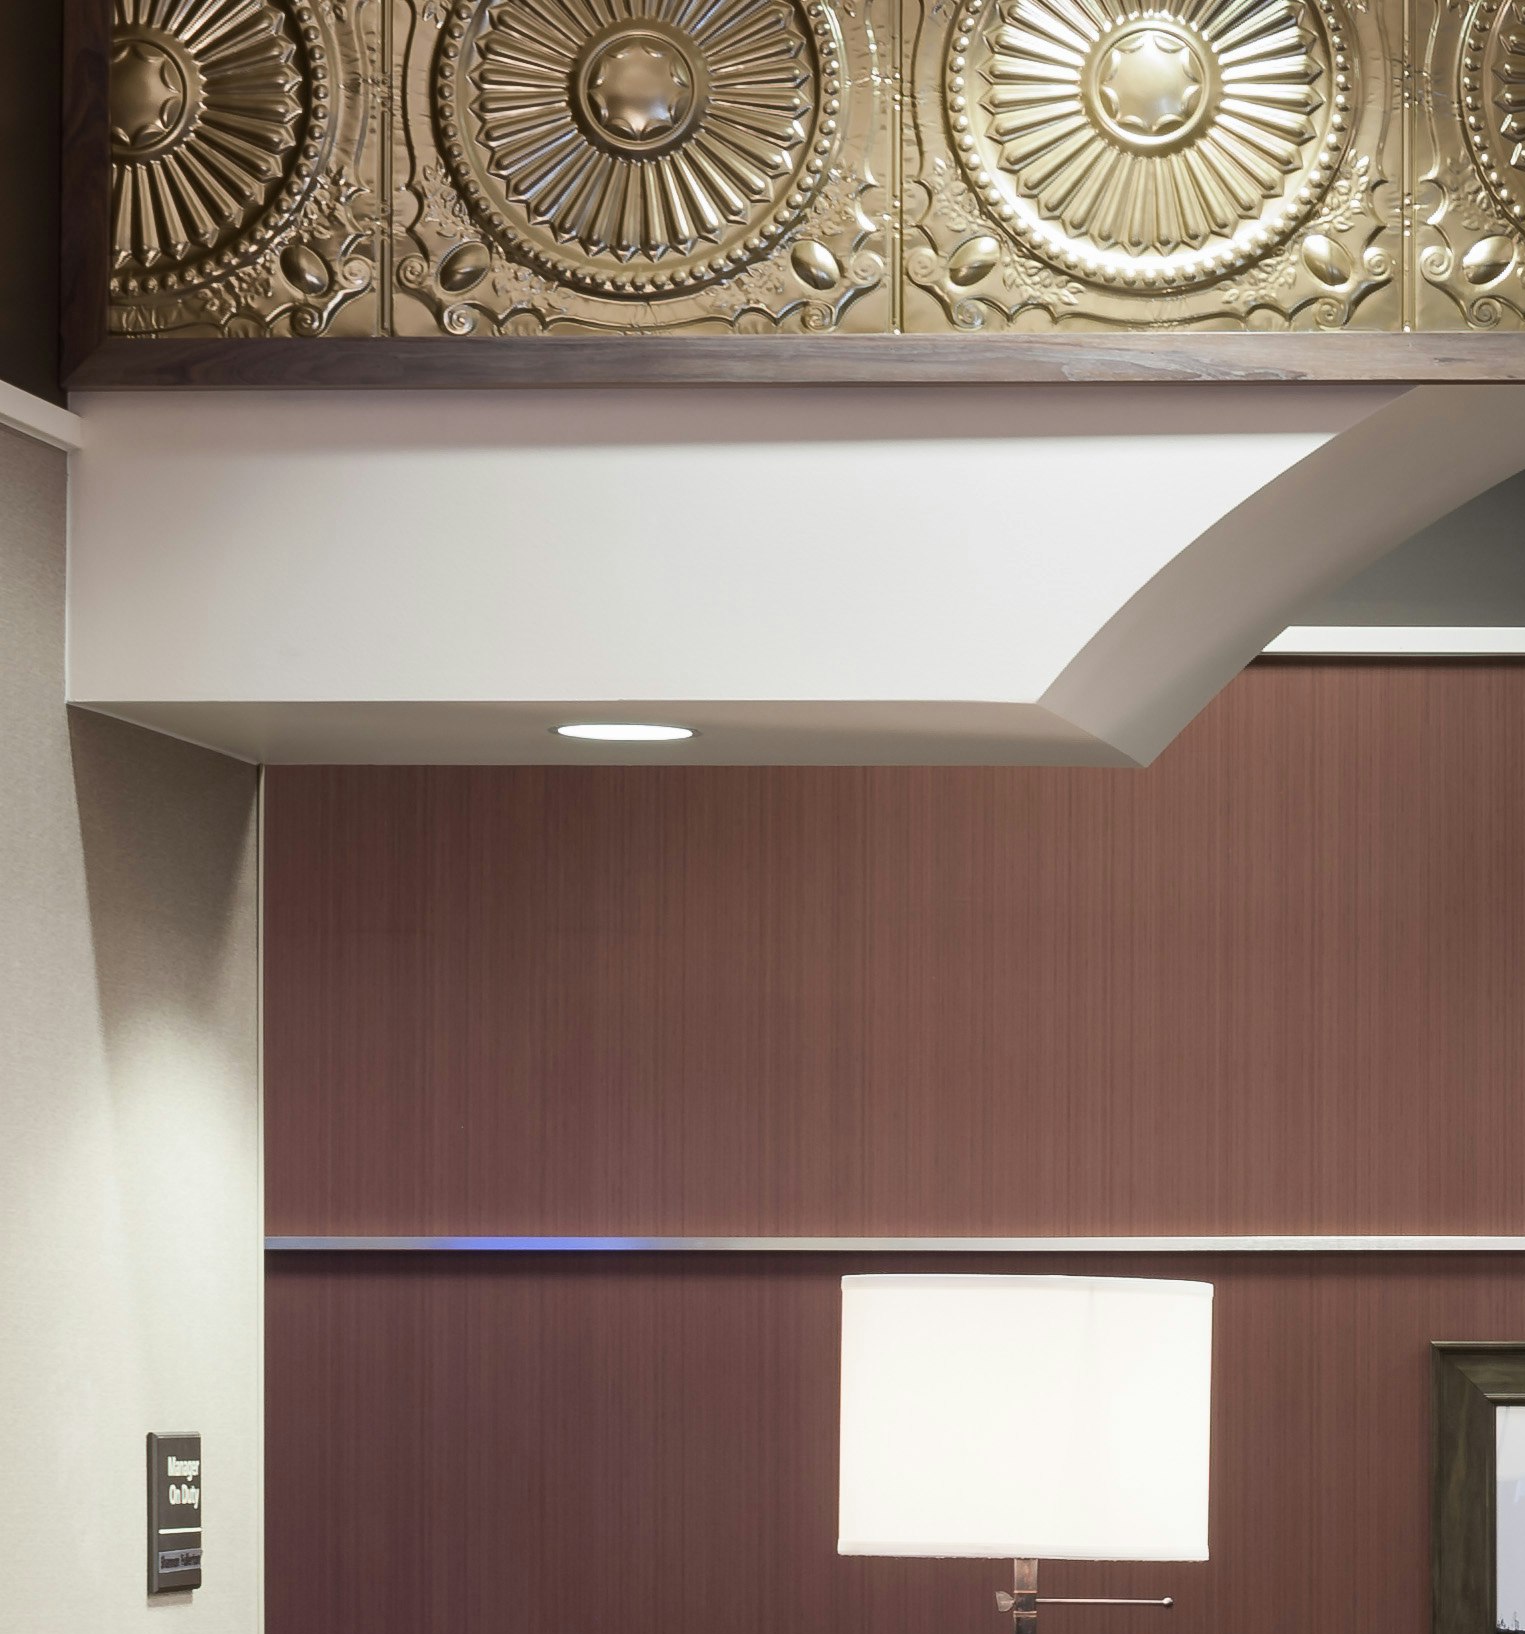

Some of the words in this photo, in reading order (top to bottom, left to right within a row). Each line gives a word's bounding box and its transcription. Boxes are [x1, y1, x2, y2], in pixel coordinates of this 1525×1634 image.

[167, 1456, 200, 1481] Manager
[169, 1484, 181, 1505] On
[181, 1484, 200, 1509] Duty
